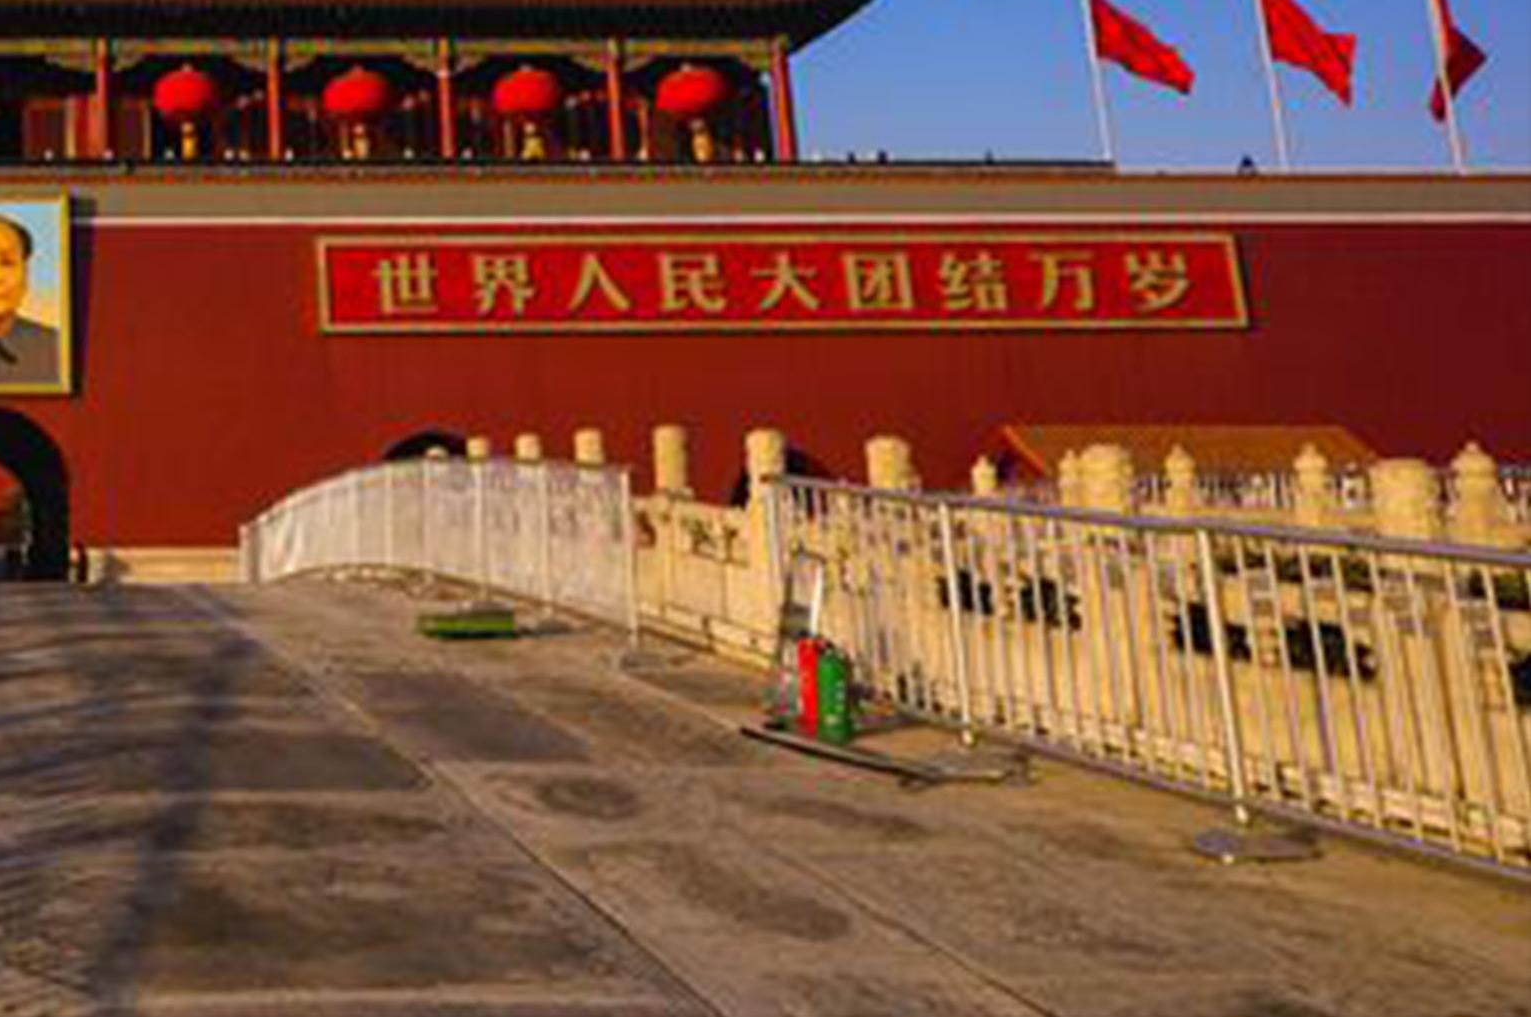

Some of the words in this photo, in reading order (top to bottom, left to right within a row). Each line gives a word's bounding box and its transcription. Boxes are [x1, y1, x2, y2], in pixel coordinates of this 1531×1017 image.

[372, 251, 1191, 312] 世界人民大团结万岁
